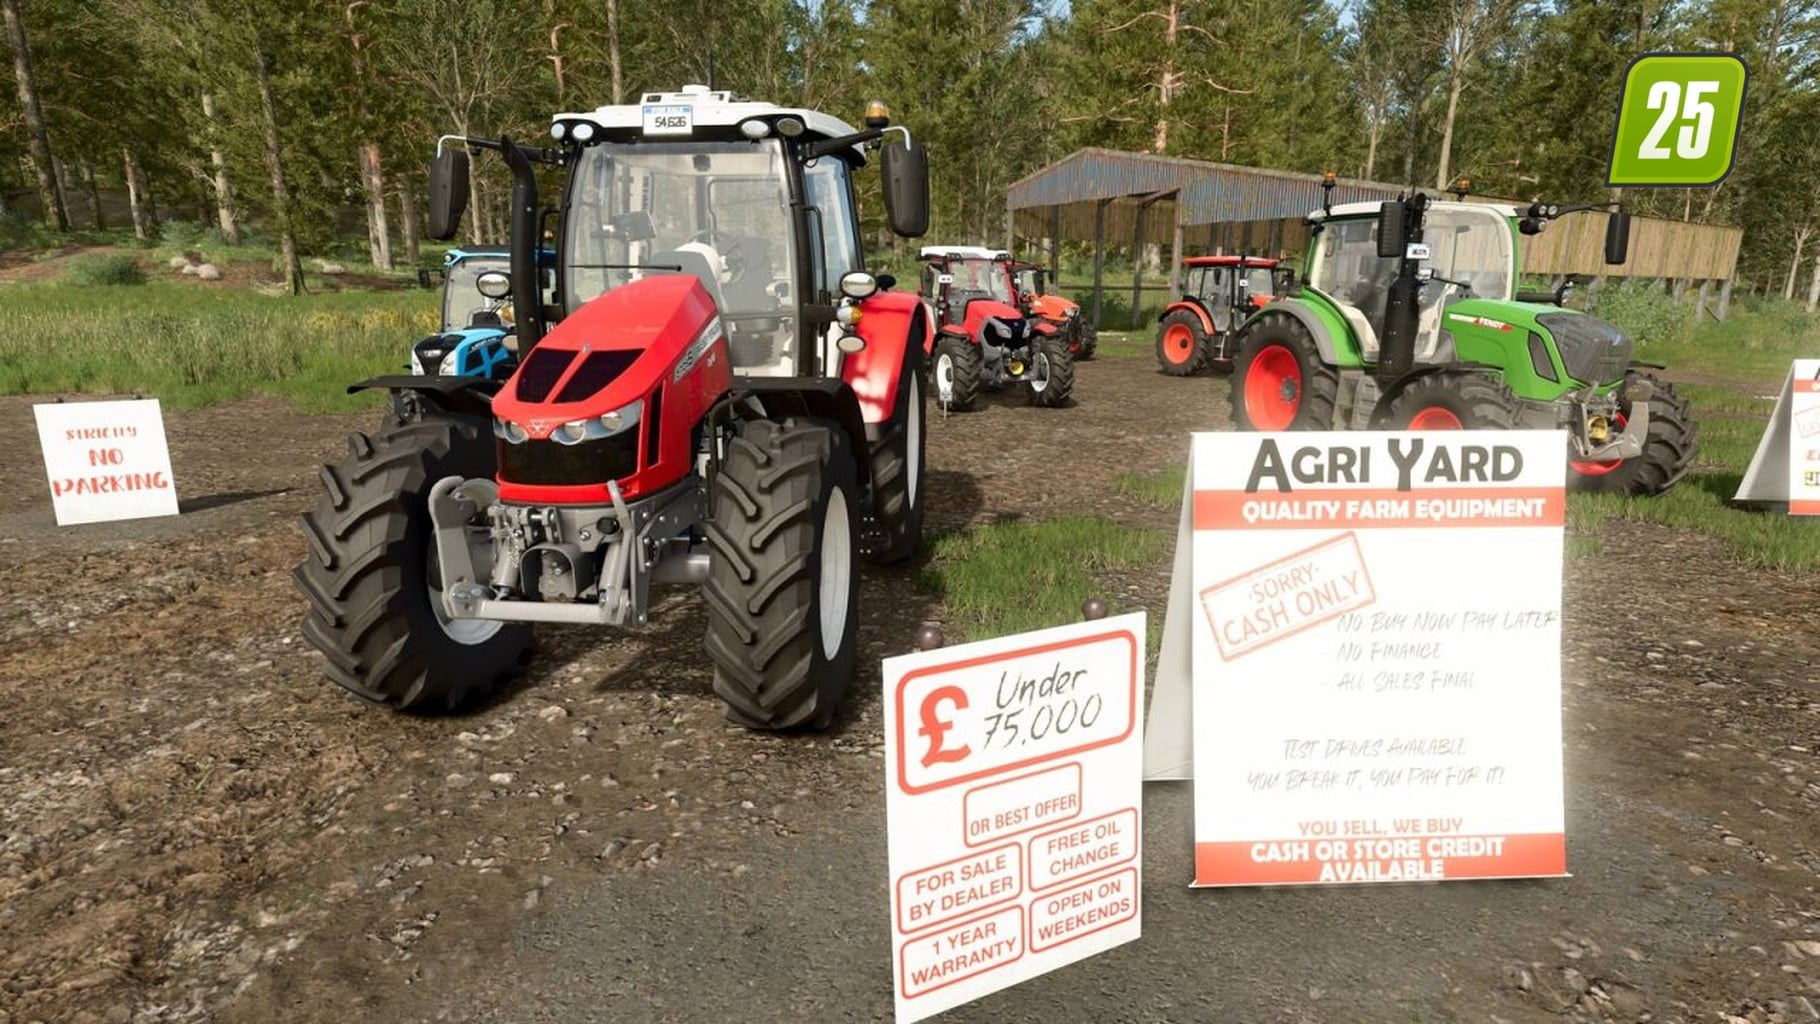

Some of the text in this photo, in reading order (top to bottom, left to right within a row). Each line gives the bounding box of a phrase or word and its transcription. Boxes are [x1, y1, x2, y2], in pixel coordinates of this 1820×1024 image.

[65, 426, 137, 440] STRICTLY
[88, 448, 124, 467] NO
[1245, 438, 1524, 493] AGRI YARD
[53, 471, 169, 497] PARKING
[1242, 497, 1547, 522] QUALITY FARM EQUIPMENT
[1223, 570, 1359, 645] CASH ONLY
[1337, 612, 1363, 632] NO
[1370, 611, 1408, 632] BUY
[1414, 611, 1457, 632] NOW
[1462, 610, 1499, 632] PAY
[1336, 641, 1444, 661] NO FINANCE
[996, 662, 1088, 709] Under
[1337, 670, 1475, 692] ALL SALES FINAL
[918, 685, 972, 768] £
[1283, 736, 1468, 760] TEST DRIVES AVAILABLE
[1247, 771, 1280, 791] YOU
[1286, 769, 1340, 791] BREAK
[1370, 768, 1403, 788] YOU
[1407, 766, 1442, 787] PAY
[1445, 766, 1479, 786] FOR
[970, 793, 1077, 836] OR BEST OFFER
[1298, 817, 1463, 836] YOU SELL, WE BUY
[1047, 820, 1121, 855] FREE OIL
[1250, 836, 1505, 862] CASH OR STORE CREDIT
[916, 854, 1007, 895] FOR SALE
[1049, 841, 1120, 876] CHANGE
[1319, 858, 1445, 882] AVAILABLE
[910, 875, 1014, 922] BY DEALER
[1047, 879, 1122, 916] OPEN ON
[1038, 897, 1131, 942] WEEKENDS
[932, 921, 997, 956] 1 YEAR
[911, 936, 1018, 987] WARRANTY
